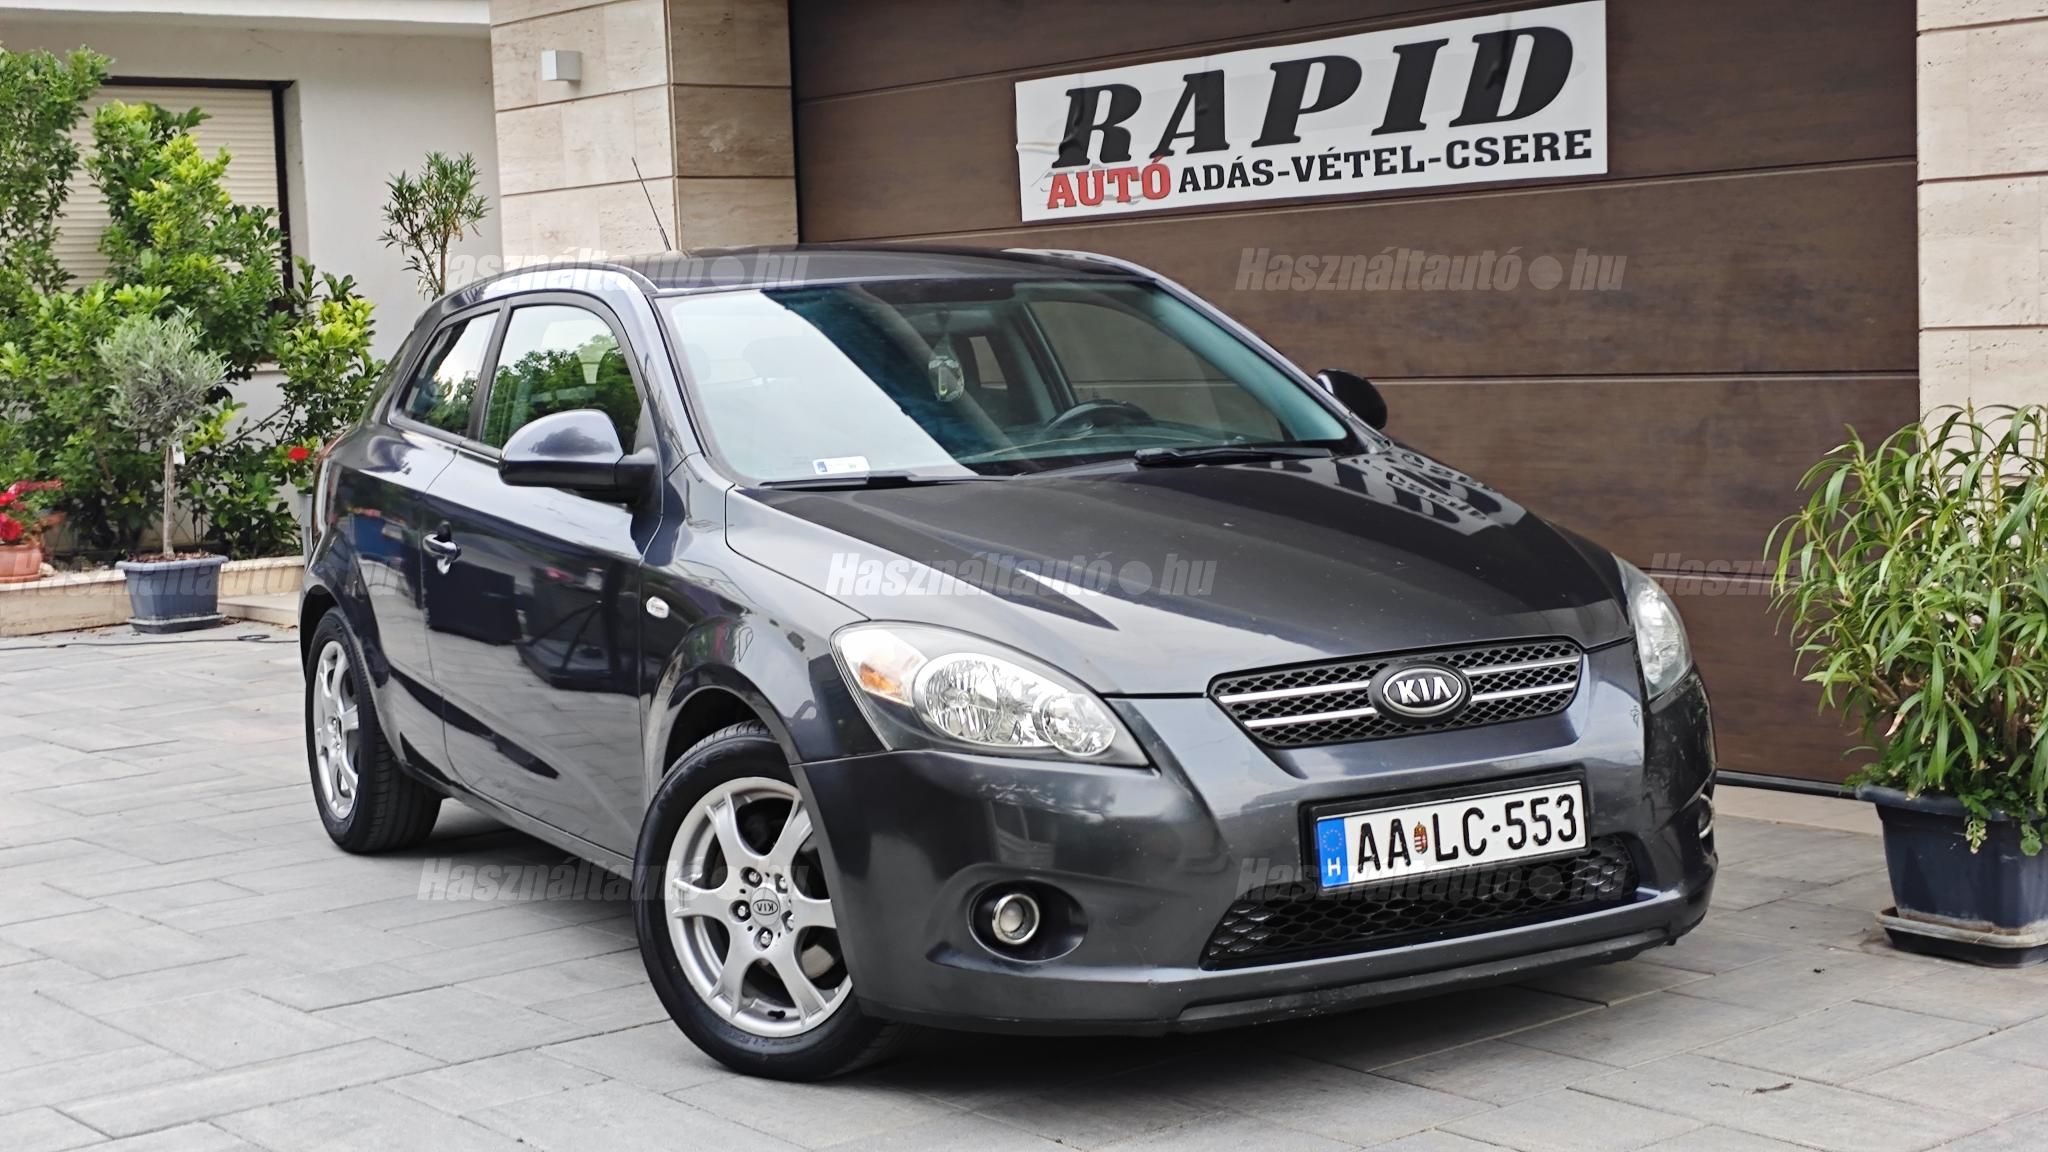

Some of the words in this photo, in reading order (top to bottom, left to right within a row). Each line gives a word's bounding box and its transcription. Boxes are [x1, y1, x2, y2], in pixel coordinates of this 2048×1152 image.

[1052, 26, 1574, 169] RAPID
[1047, 154, 1172, 209] AUTÓ
[1399, 675, 1453, 704] KIA
[1328, 859, 1341, 877] H
